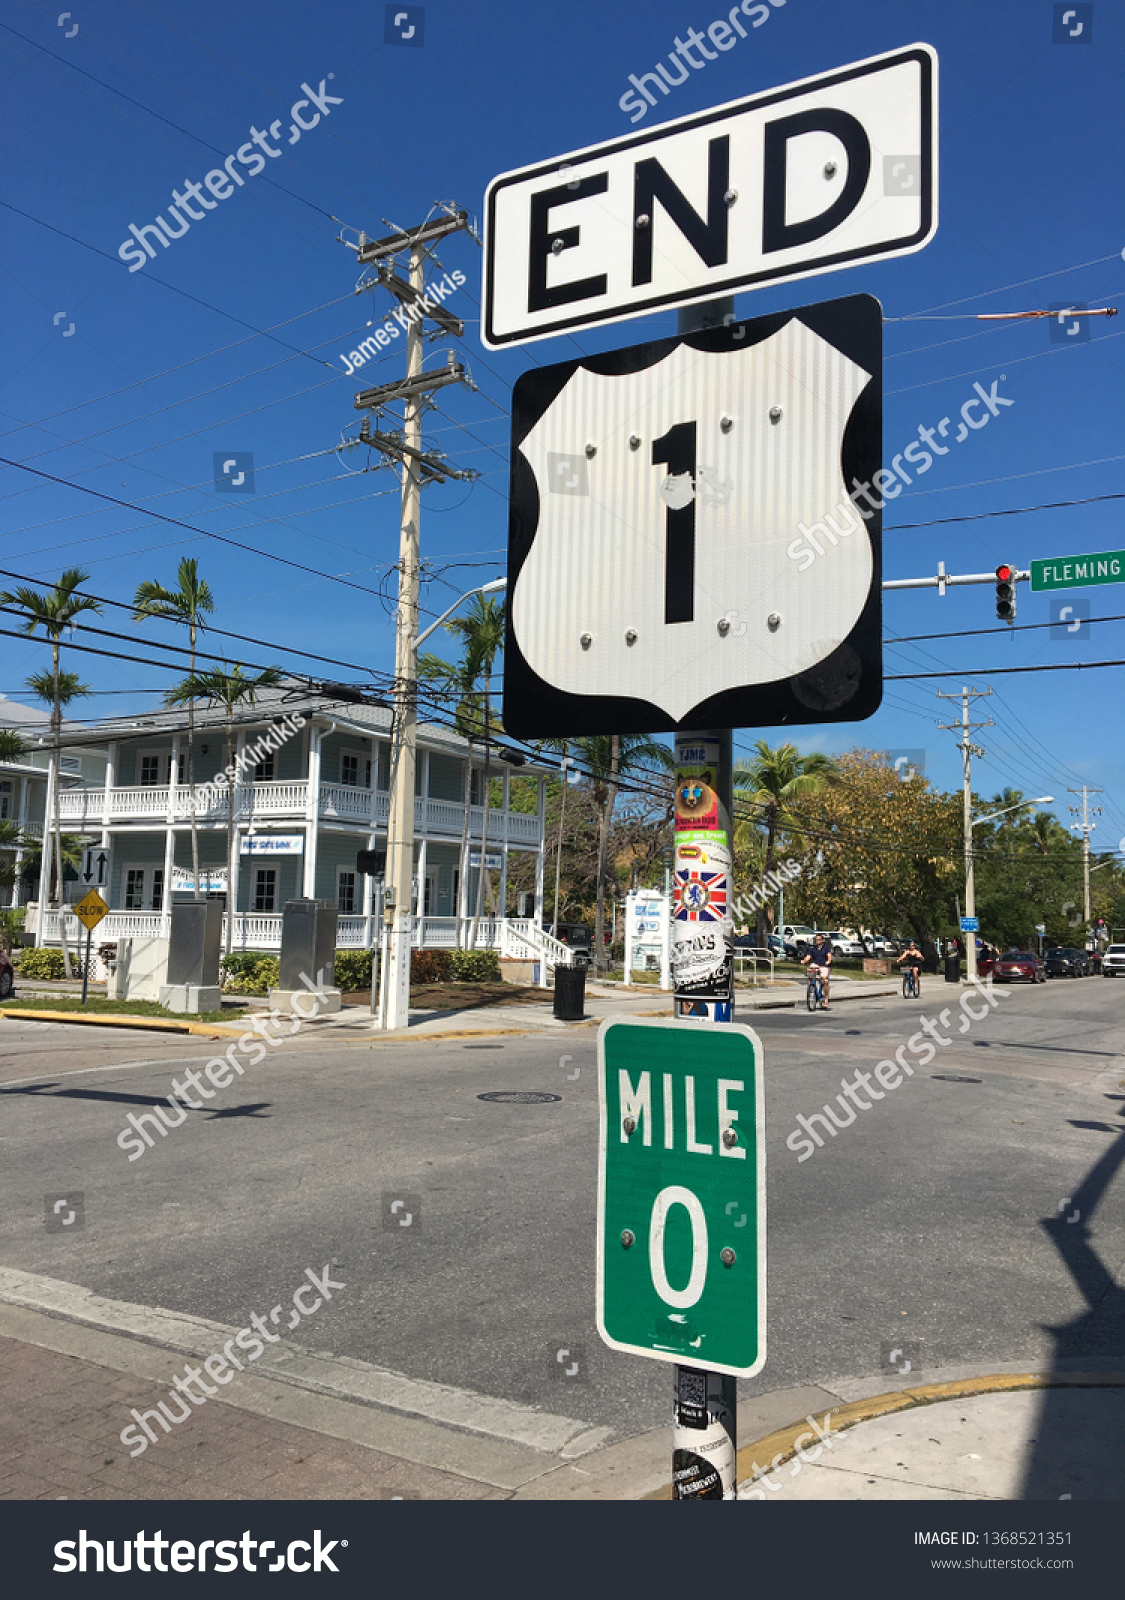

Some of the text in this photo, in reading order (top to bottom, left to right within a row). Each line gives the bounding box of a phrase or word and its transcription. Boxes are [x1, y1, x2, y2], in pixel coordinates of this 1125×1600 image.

[528, 107, 871, 313] END
[651, 420, 697, 624] 1
[1043, 559, 1121, 583] FLEMING
[79, 905, 104, 916] SLOW
[618, 1069, 747, 1160] MILE
[650, 1185, 709, 1309] 0
